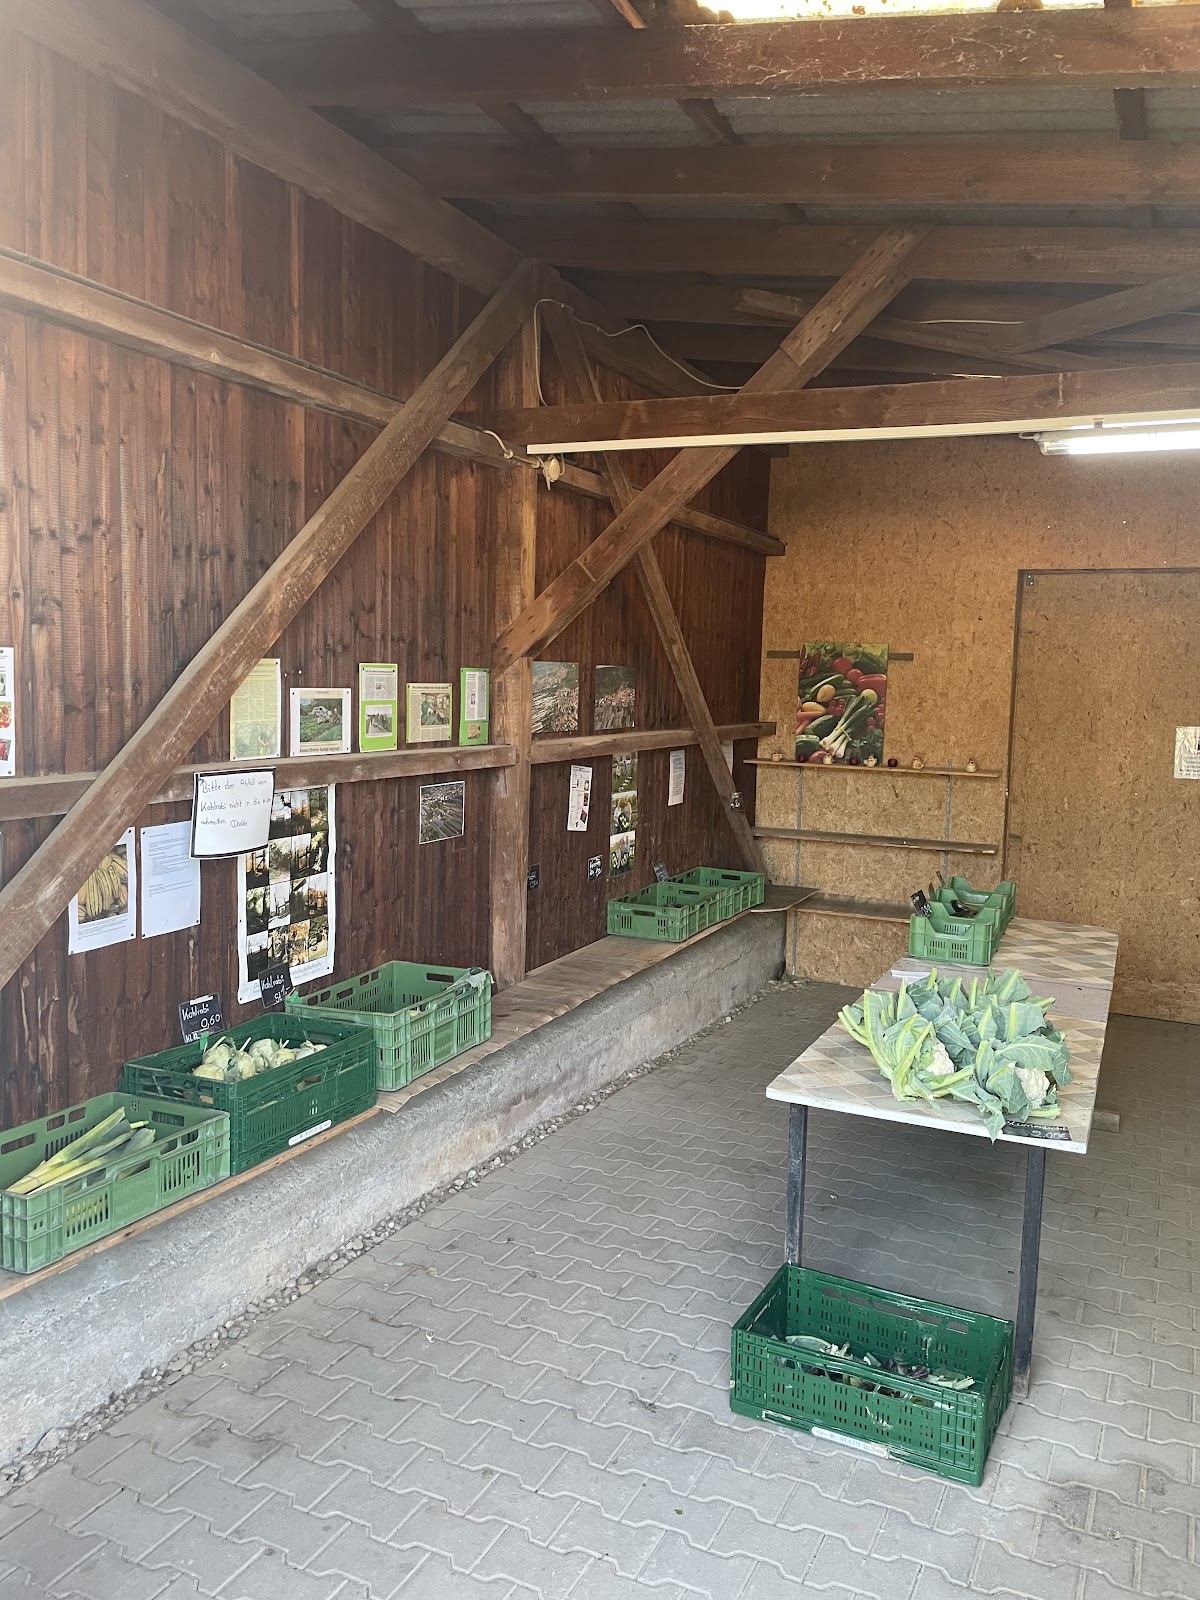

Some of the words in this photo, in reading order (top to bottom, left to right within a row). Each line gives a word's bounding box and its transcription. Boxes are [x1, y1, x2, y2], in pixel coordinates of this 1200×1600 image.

[202, 779, 221, 793] Bitte
[201, 800, 226, 813] Kohlrabi
[229, 799, 242, 809] nicht
[181, 1003, 210, 1021] Kohlrabi
[200, 1013, 221, 1029] 0,60
